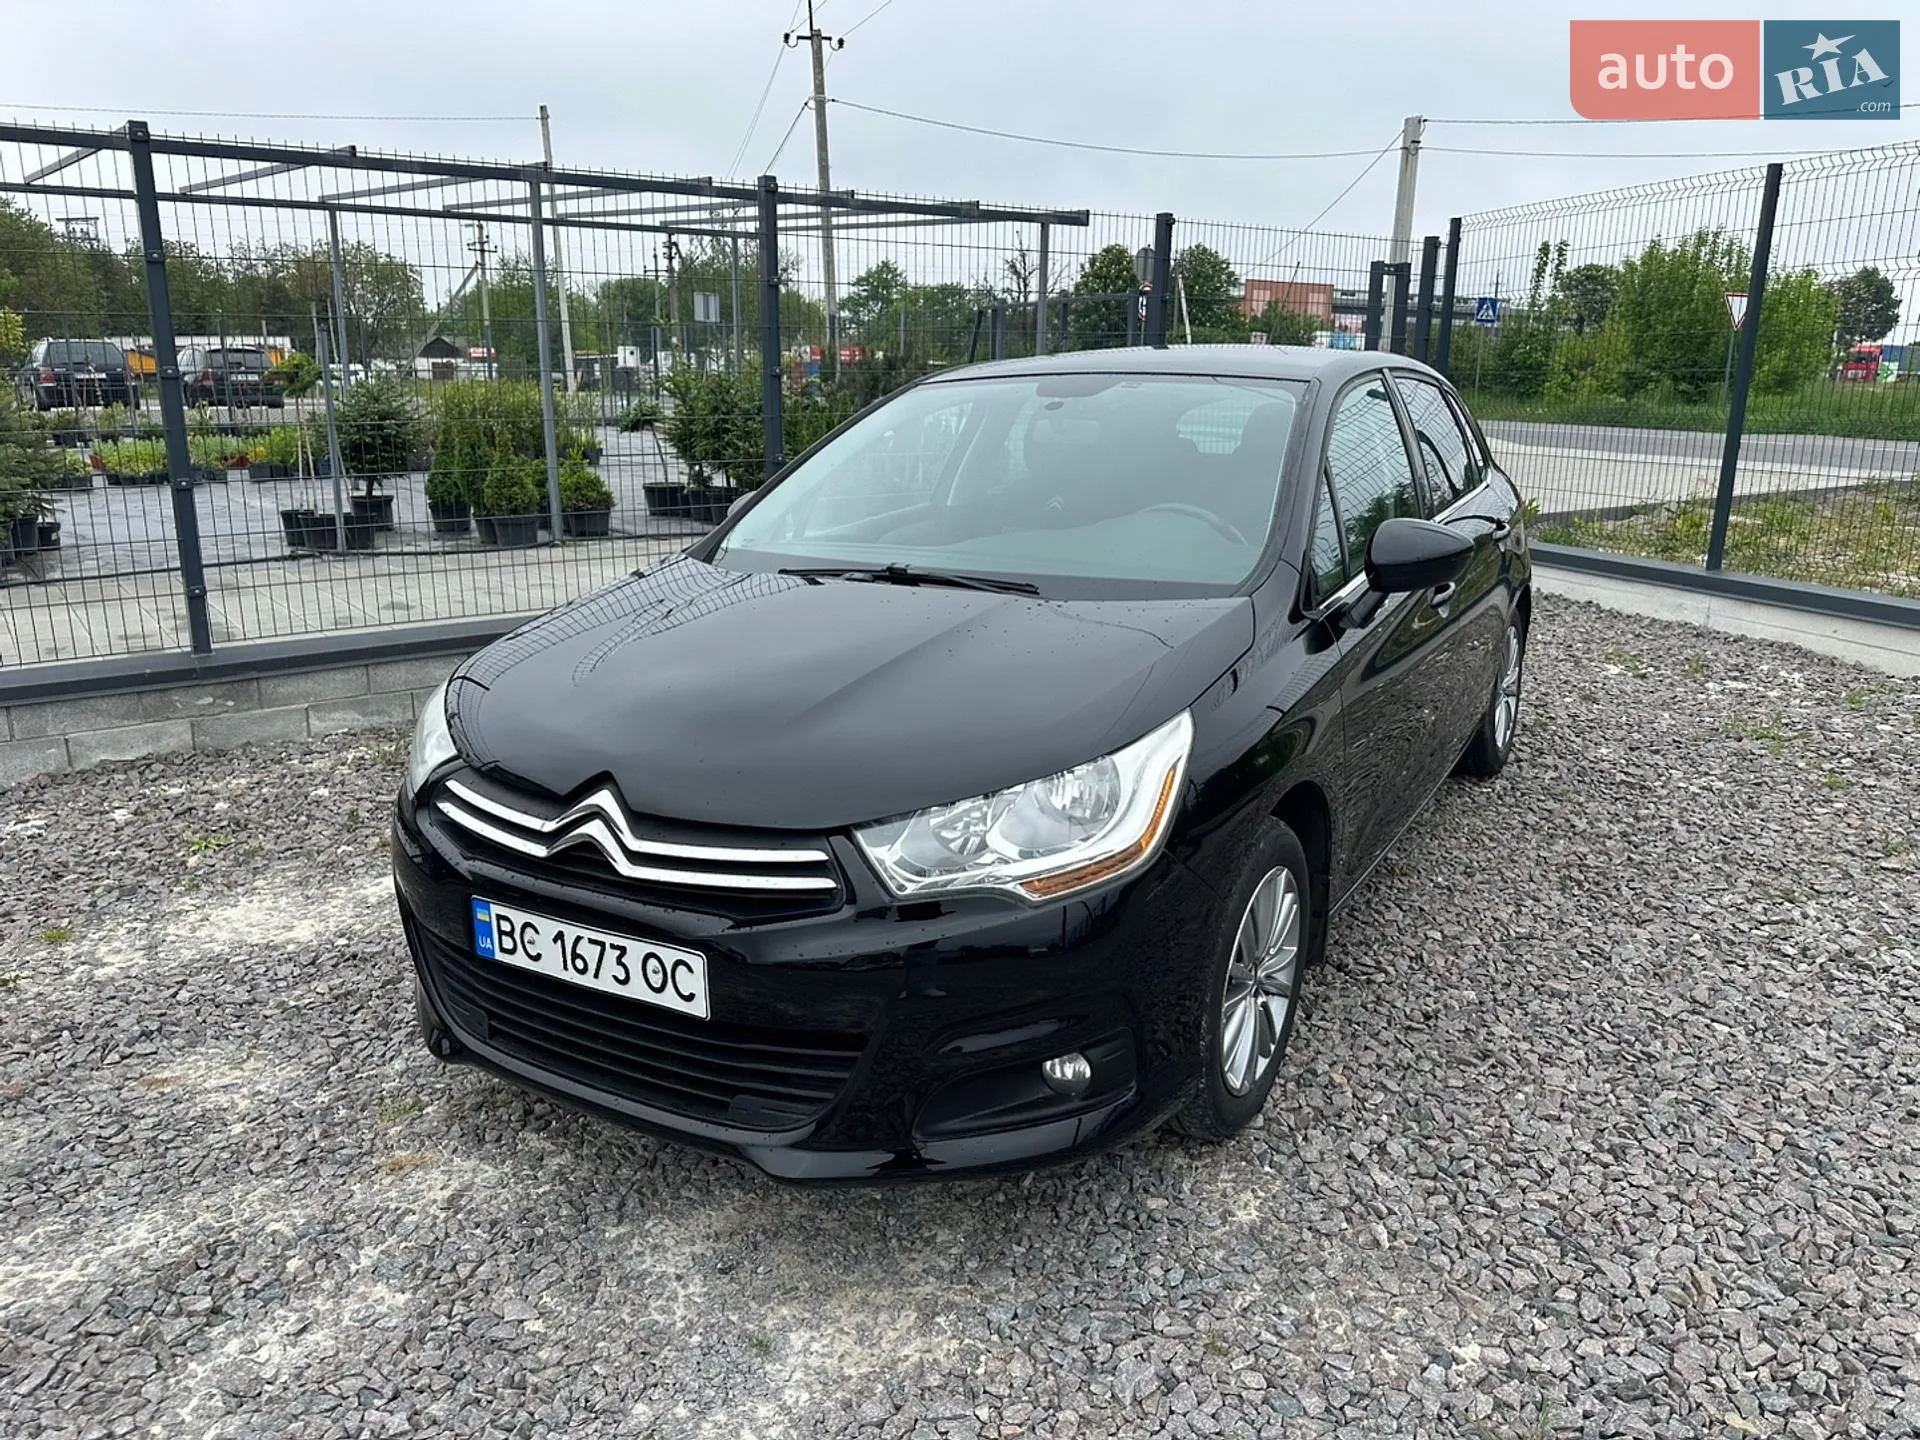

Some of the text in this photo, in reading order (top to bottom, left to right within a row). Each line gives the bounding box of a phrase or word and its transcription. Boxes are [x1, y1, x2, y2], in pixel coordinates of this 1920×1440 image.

[479, 936, 493, 950] UA
[495, 914, 696, 1002] BC 1673 OC
